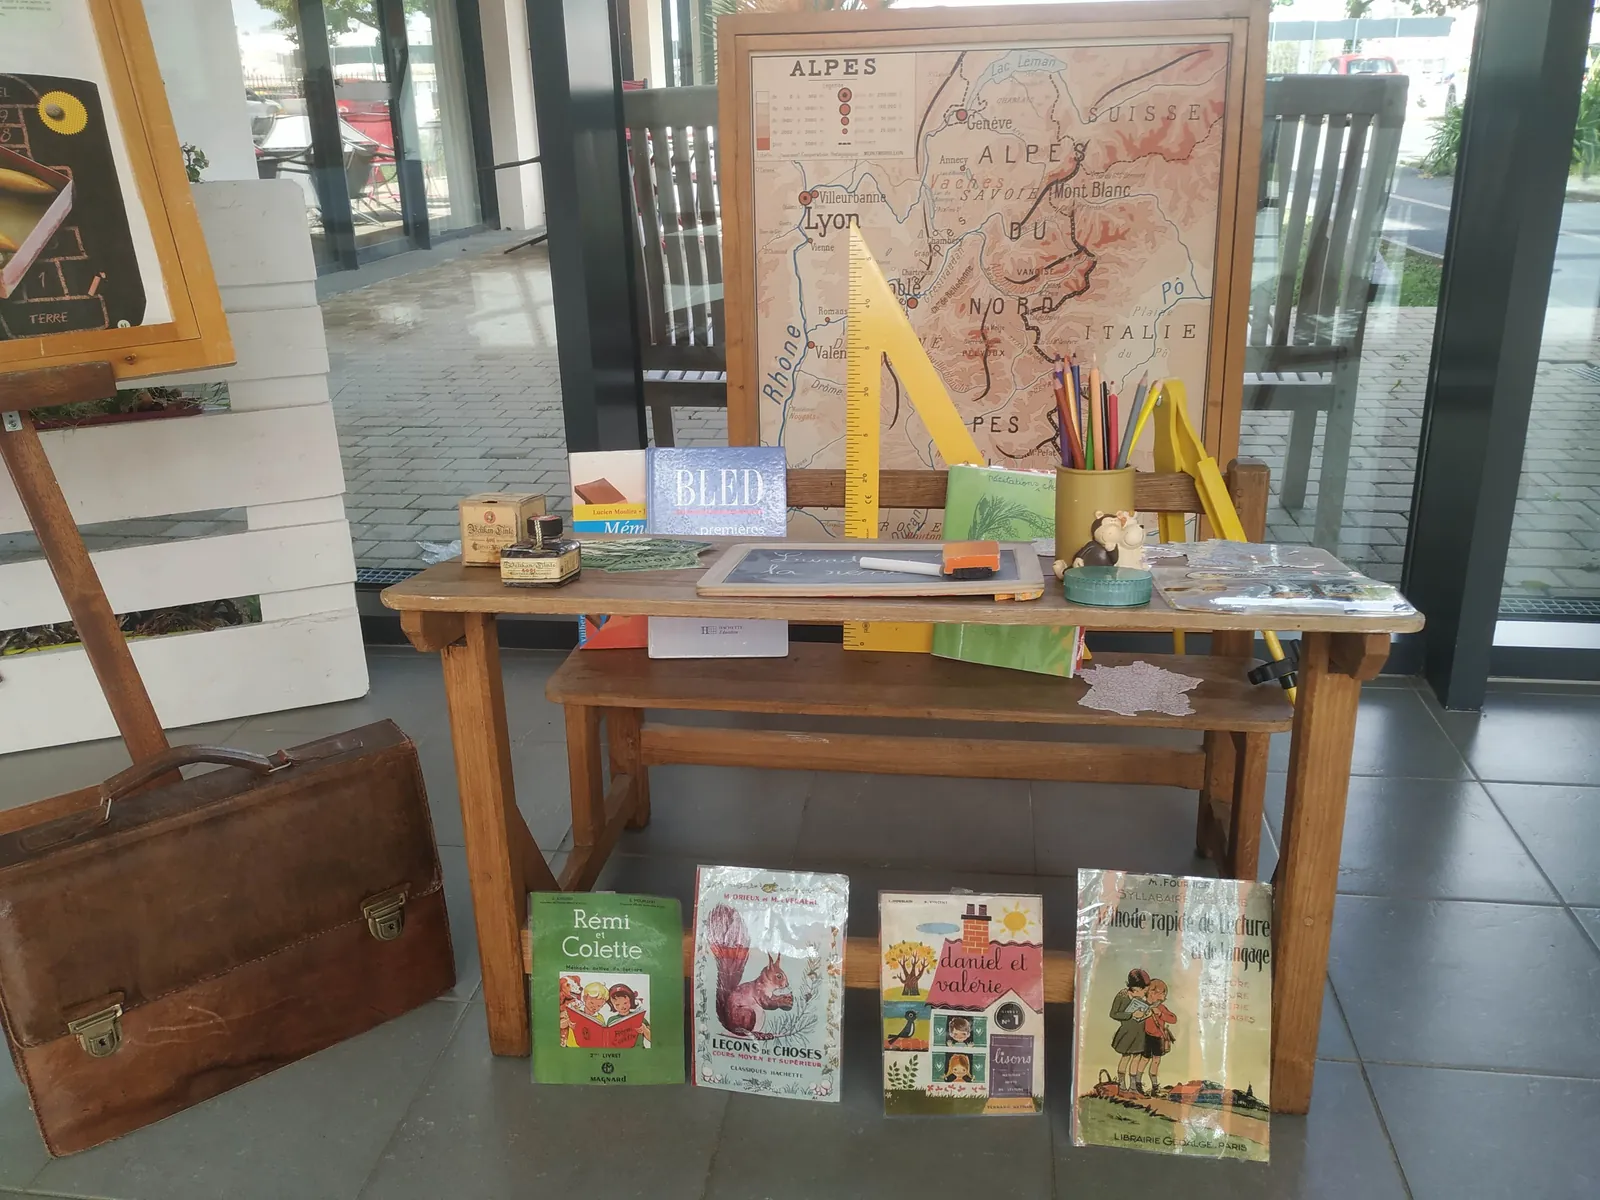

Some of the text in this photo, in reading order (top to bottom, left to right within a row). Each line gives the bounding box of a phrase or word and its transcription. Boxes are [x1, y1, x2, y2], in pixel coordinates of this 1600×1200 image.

[789, 58, 877, 77] ALPES
[991, 54, 1056, 77] Lac Léman
[967, 113, 1012, 131] Genève
[1088, 104, 1201, 122] SUISSE
[1, 128, 11, 142] 8
[939, 155, 969, 167] Annecy
[978, 142, 1085, 164] ALPES
[931, 173, 1005, 190] Vaches
[1054, 180, 1132, 199] Mont Blanc
[819, 190, 887, 204] Villeurbanne
[960, 187, 1040, 201] SAVOIE
[804, 206, 861, 238] Lyon
[1010, 220, 1047, 241] DU
[811, 243, 835, 252] Vienne
[38, 271, 46, 288] 1
[818, 306, 848, 316] Romans
[969, 296, 1053, 315] NORD
[29, 311, 69, 324] TERRE
[1085, 324, 1196, 340] ITALIE
[815, 345, 847, 360] Valen
[762, 324, 801, 405] Rhône
[811, 379, 843, 396] Drôme
[973, 416, 1019, 433] PES
[674, 468, 765, 507] BLED
[592, 508, 613, 516] Lucien
[604, 519, 647, 535] Mém
[700, 524, 765, 536] premières
[573, 908, 631, 930] Rémi
[595, 931, 605, 939] et
[562, 936, 643, 960] Colette
[940, 946, 1028, 971] daniel et
[936, 971, 1003, 994] valérie
[712, 1038, 822, 1060] LEÇONS DE CHOSES
[992, 1047, 1032, 1065] lisons
[712, 1050, 736, 1058] COURS
[738, 1053, 763, 1062] MOYEN
[779, 1058, 822, 1068] SUPÉRIEUR
[730, 1065, 803, 1079] CLASSIQUES HACHETTE
[1114, 1132, 1161, 1145] LIBRAIRIE
[1218, 1141, 1248, 1152] PARIS
